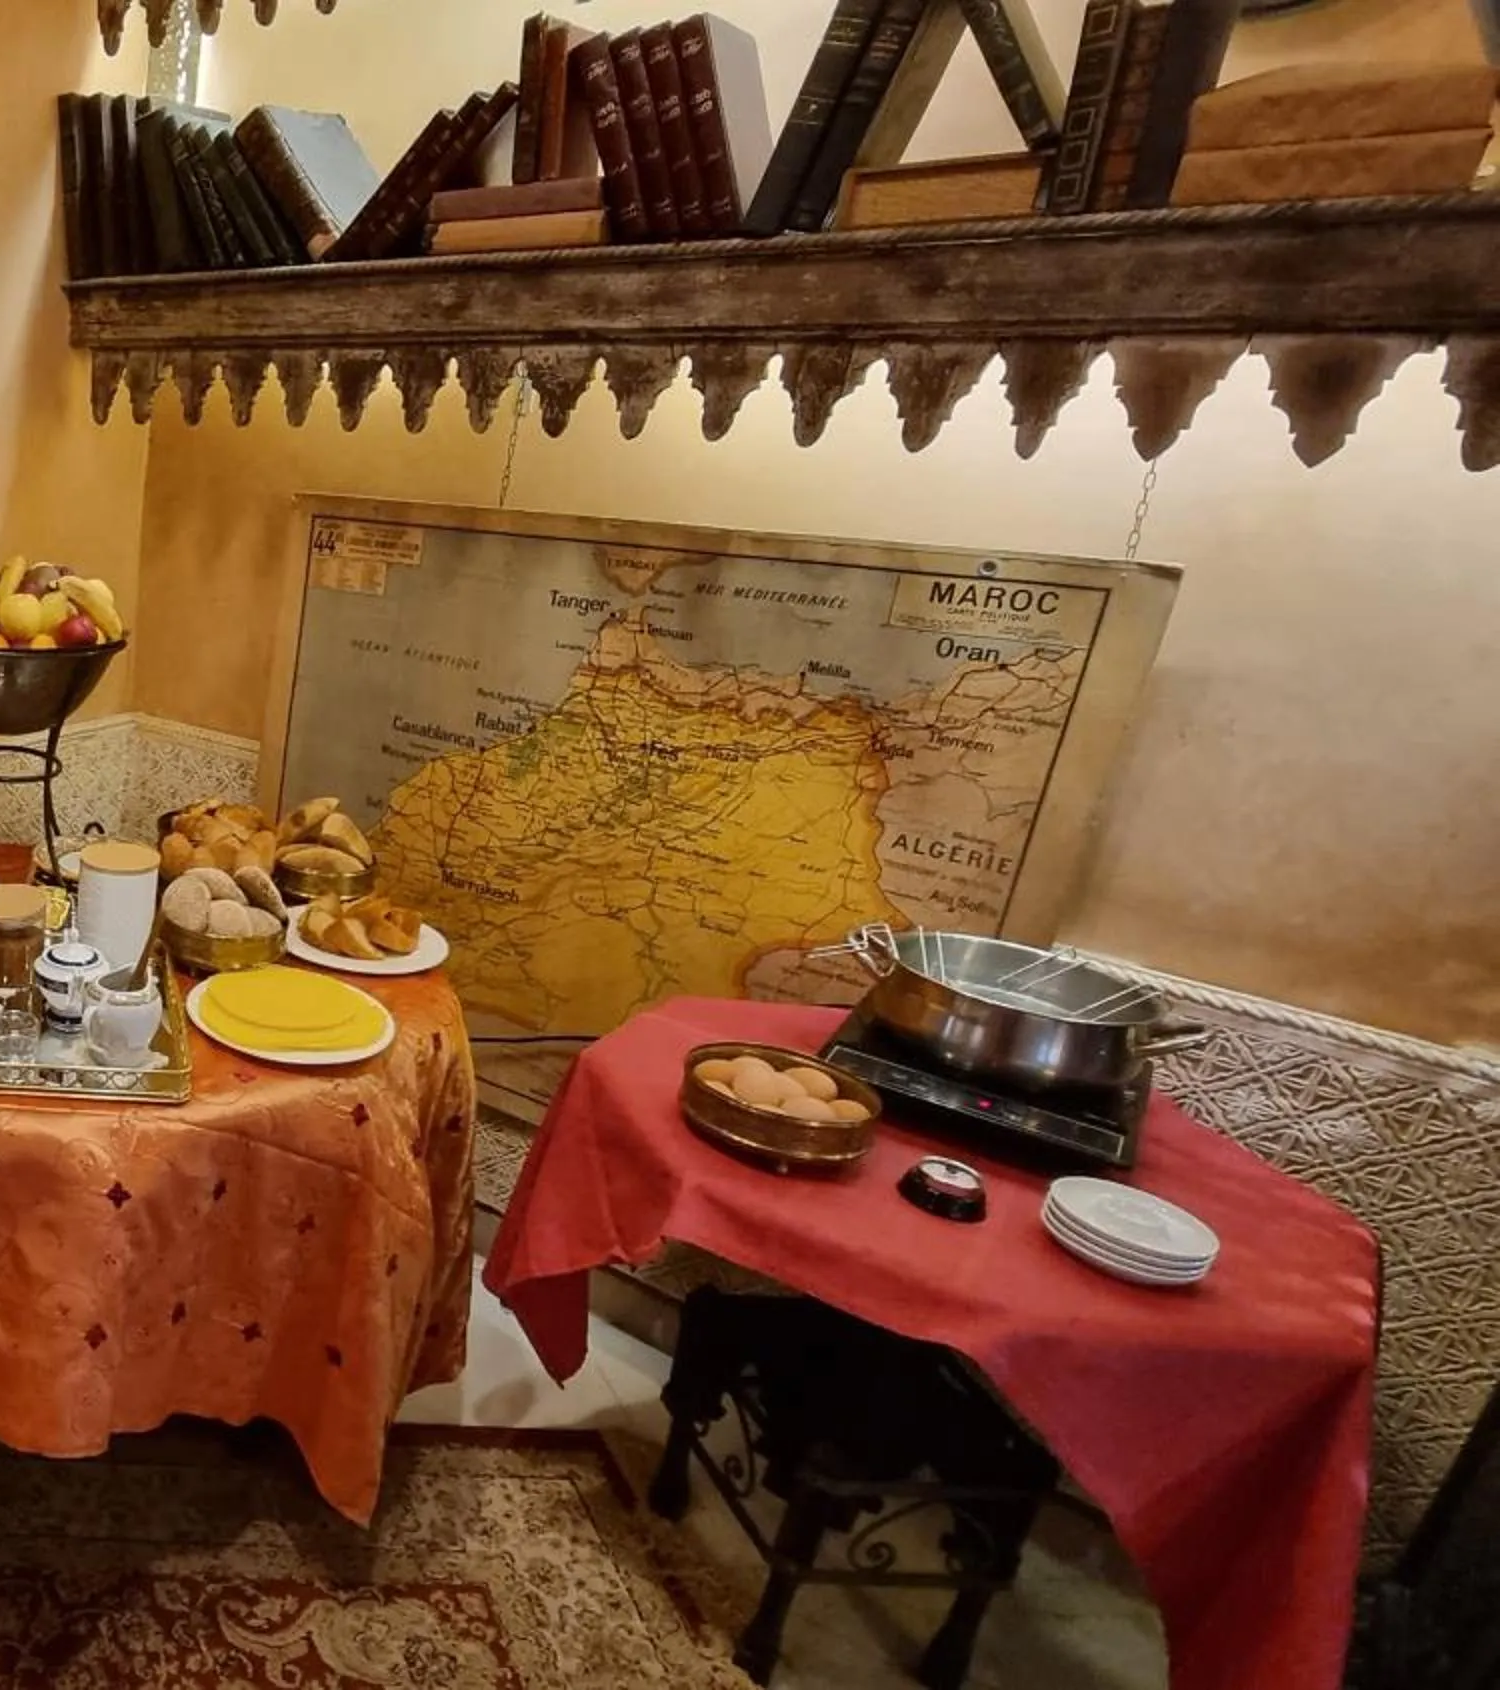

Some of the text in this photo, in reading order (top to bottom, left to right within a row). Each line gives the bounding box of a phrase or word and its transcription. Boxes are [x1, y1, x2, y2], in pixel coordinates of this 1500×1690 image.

[313, 528, 337, 552] 44
[549, 588, 612, 617] Tanger
[693, 582, 725, 597] MER
[928, 580, 1061, 616] MAROC
[946, 606, 975, 618] CARTE
[979, 609, 1031, 624] POLITIQUE
[935, 636, 1001, 664] Oran
[807, 659, 852, 679] Melilla
[392, 714, 476, 749] Casablanca
[474, 710, 523, 736] Rabat
[927, 729, 997, 754] Tlemcen
[891, 832, 1014, 877] ALGÉRIE
[441, 867, 520, 905] Marrakech
